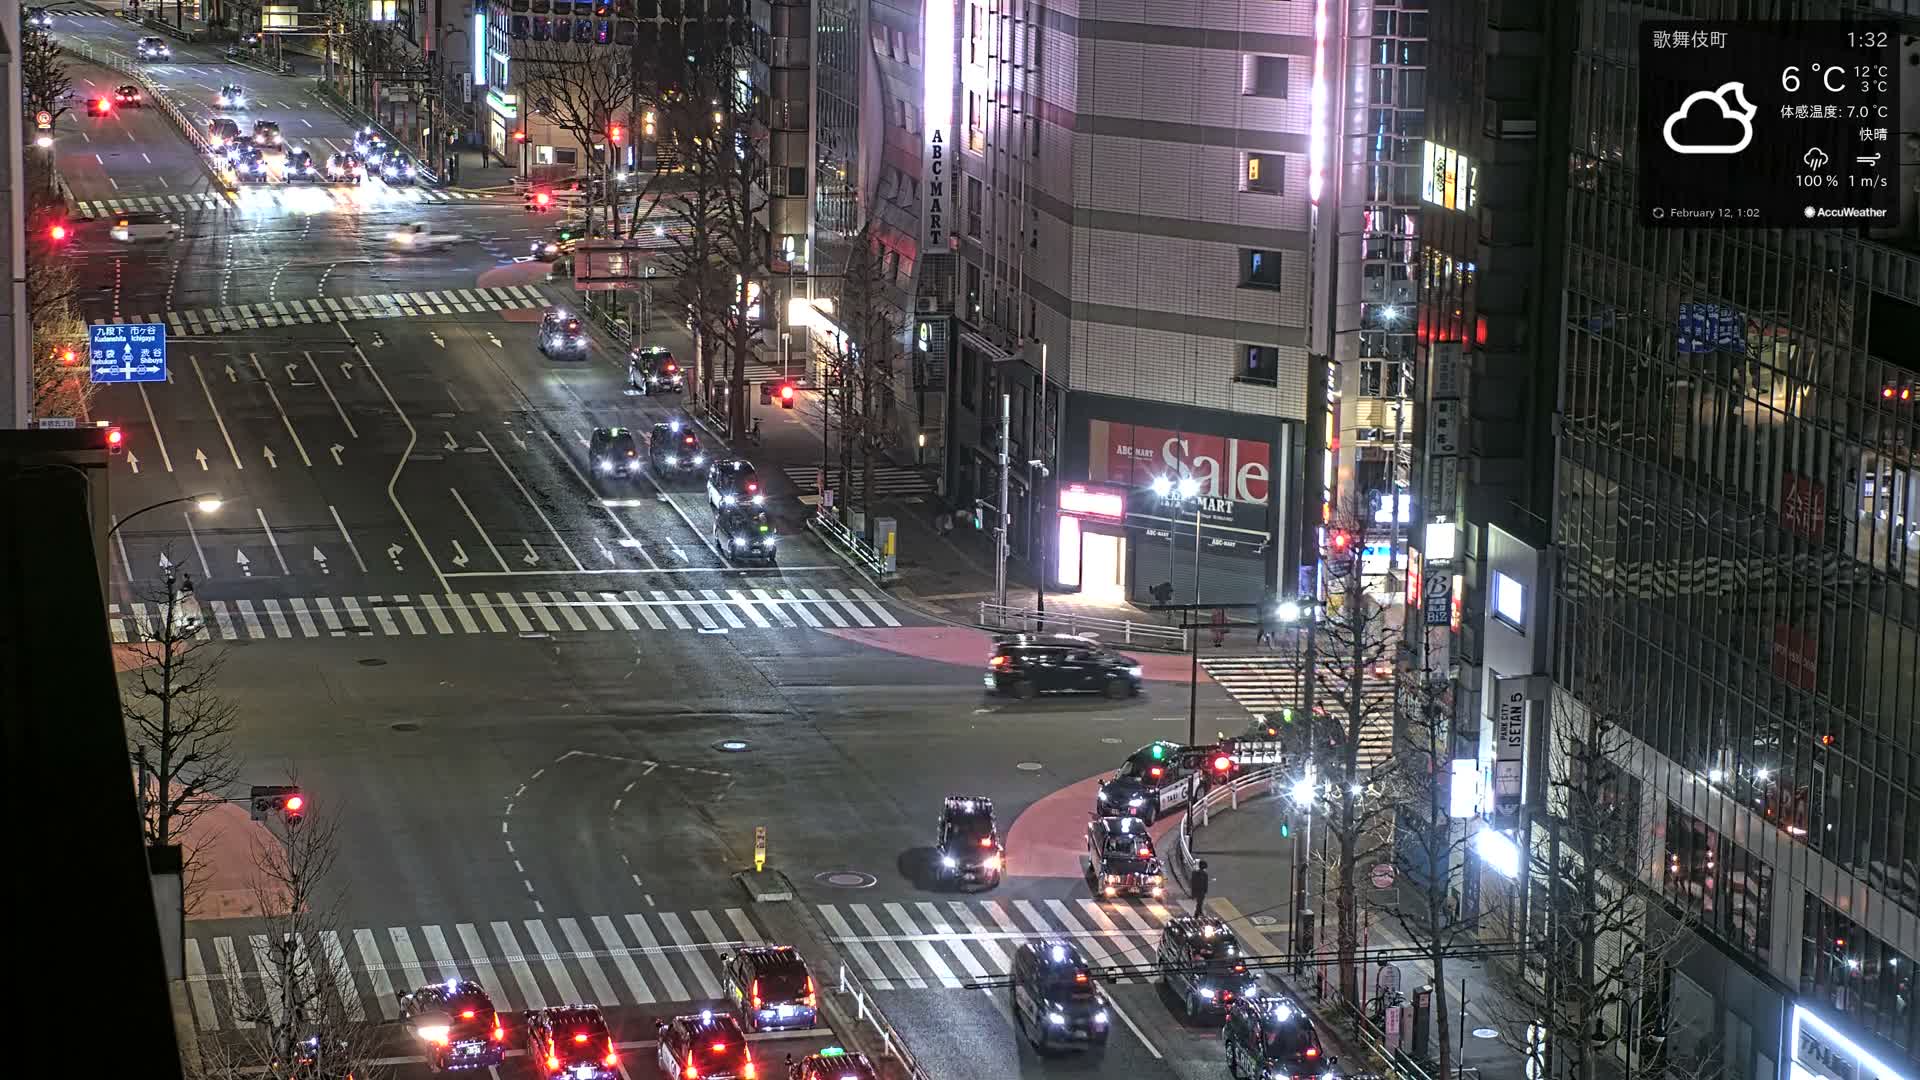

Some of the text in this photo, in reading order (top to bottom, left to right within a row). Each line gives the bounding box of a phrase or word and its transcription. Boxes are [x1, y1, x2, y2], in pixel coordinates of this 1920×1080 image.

[97, 327, 124, 336] 九段下
[1162, 438, 1268, 504] Sale
[1508, 692, 1523, 747] ISETAN 5
